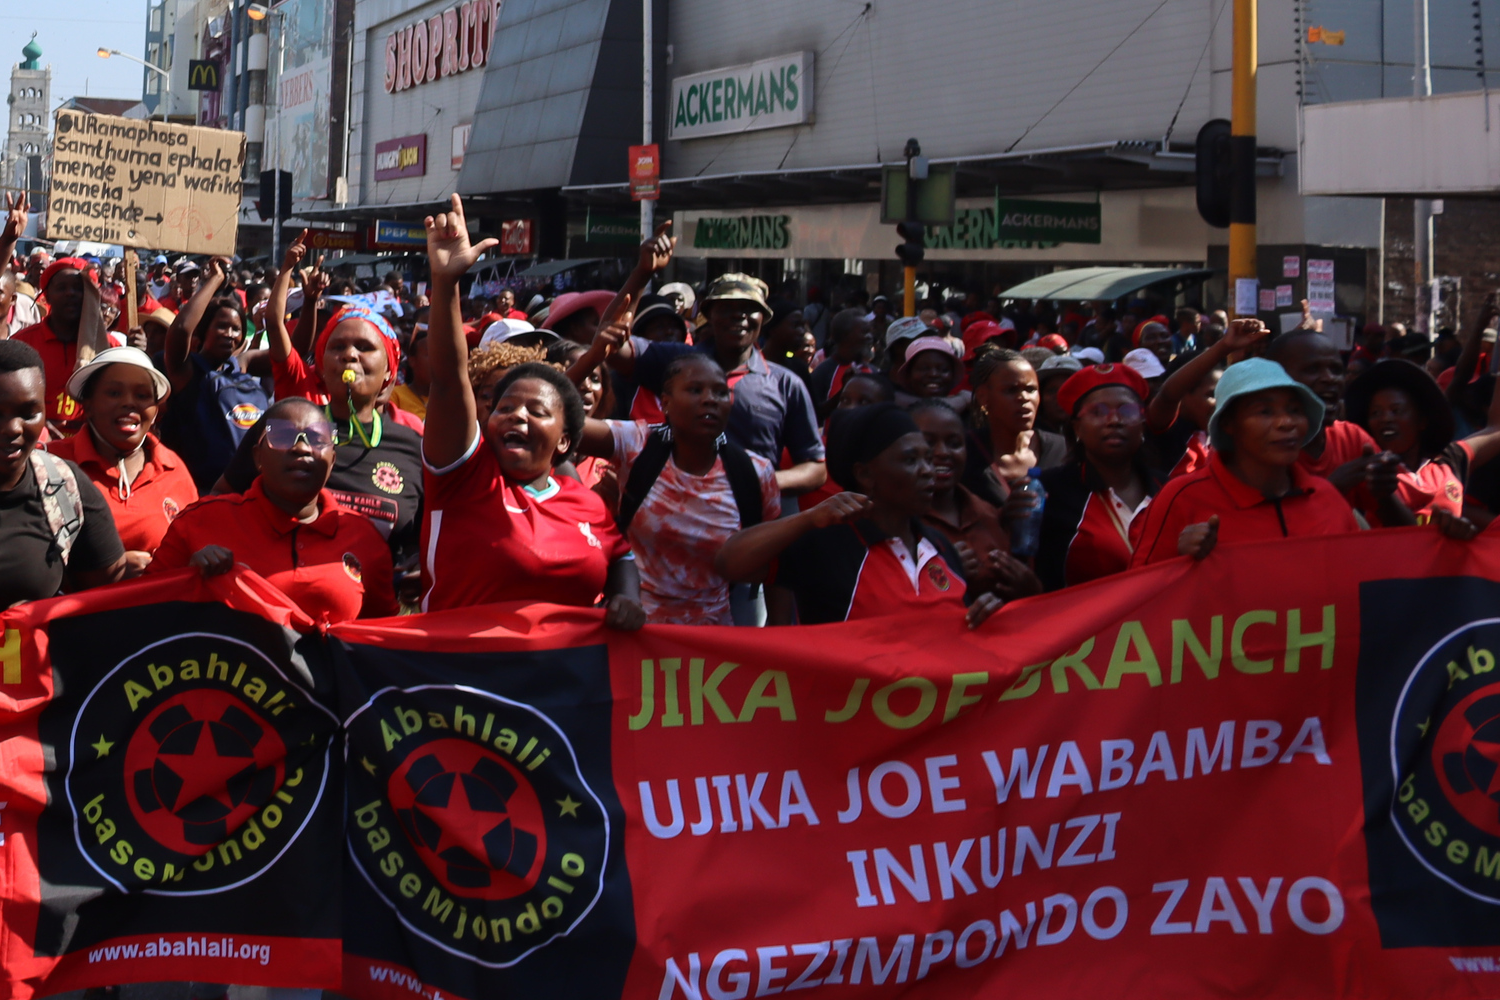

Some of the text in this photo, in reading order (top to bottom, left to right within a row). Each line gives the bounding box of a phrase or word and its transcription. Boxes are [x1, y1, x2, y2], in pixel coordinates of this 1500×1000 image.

[674, 64, 799, 128] ACKERMANS
[55, 160, 116, 182] mende
[128, 168, 176, 191] yena
[52, 197, 143, 224] amasende
[1002, 213, 1098, 230] ACKERMANS
[385, 227, 407, 238] PEP
[590, 225, 641, 236] ACKERMA
[694, 215, 790, 249] ACKERMANS
[56, 393, 76, 416] 15
[628, 657, 797, 730] JIKA
[380, 705, 551, 771] Abahlali
[638, 716, 1332, 839] UJIKA JOE WABAMBA
[354, 800, 585, 943] baseMjondolo
[846, 812, 1122, 907] INKUNZI
[88, 937, 271, 965] www.abahlali.org
[657, 876, 1345, 1000] NGEZIMPONDO ZAYO
